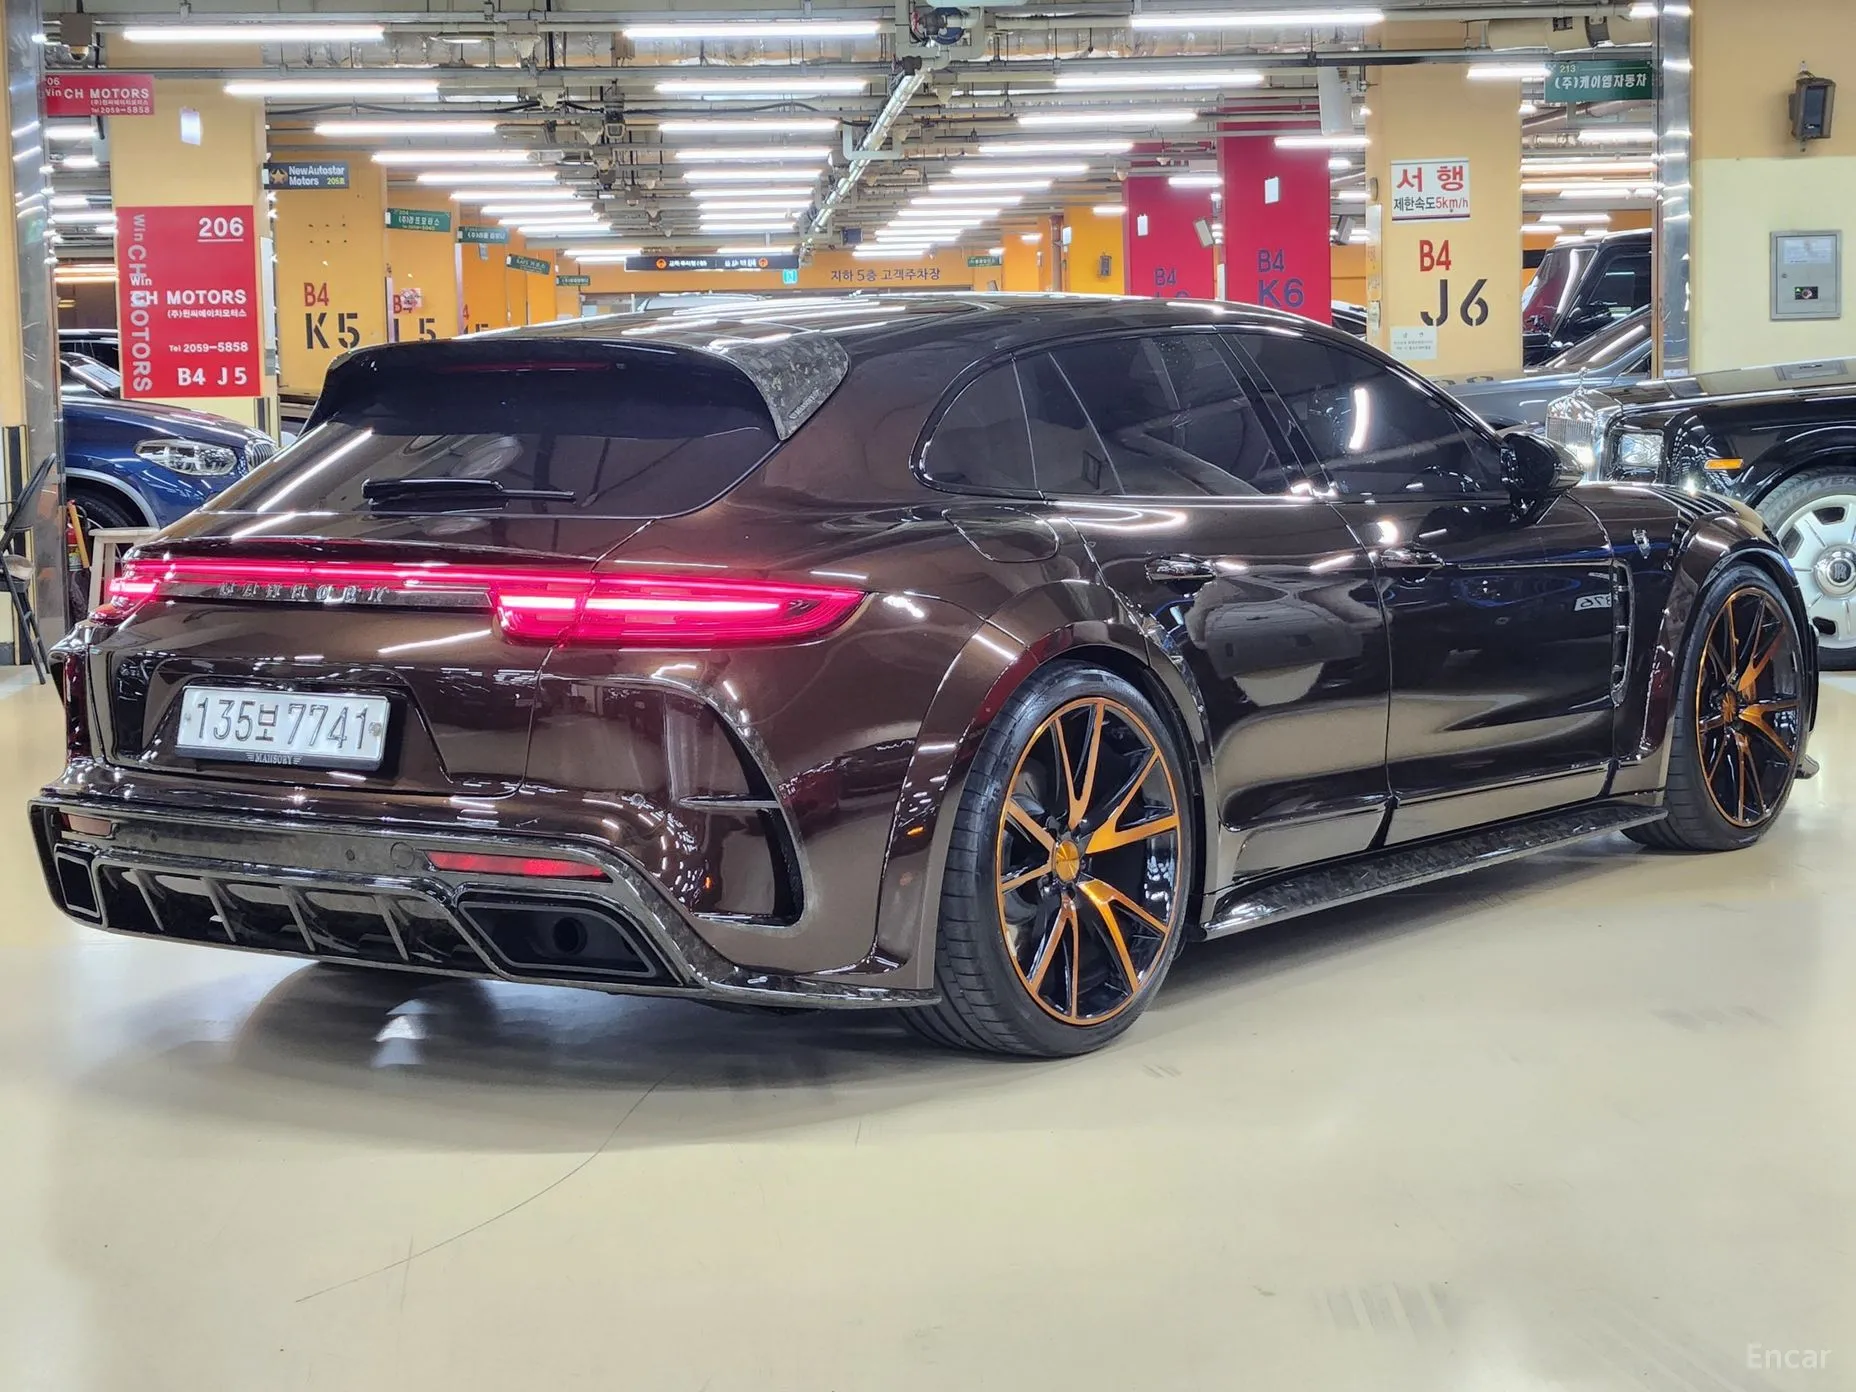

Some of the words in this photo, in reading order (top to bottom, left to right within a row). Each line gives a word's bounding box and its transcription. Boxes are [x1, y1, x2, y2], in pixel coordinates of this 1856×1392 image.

[1560, 65, 1576, 73] 213
[47, 77, 60, 85] 06
[64, 88, 84, 99] CH
[90, 88, 149, 99] MOTORS
[101, 106, 150, 114] 2059-5858
[289, 176, 319, 185] Motors
[133, 214, 146, 242] Win
[198, 217, 244, 238] 206
[1257, 249, 1286, 273] B4
[1419, 239, 1452, 272] B4
[130, 275, 152, 286] Win
[831, 269, 853, 282] 지하
[881, 268, 941, 281] 고객주차장
[1154, 268, 1176, 286] B4
[166, 289, 247, 305] MOTORS
[304, 282, 330, 306] B4
[183, 341, 249, 353] 2059-5858
[177, 367, 206, 386] B4
[287, 702, 369, 750] 7741
